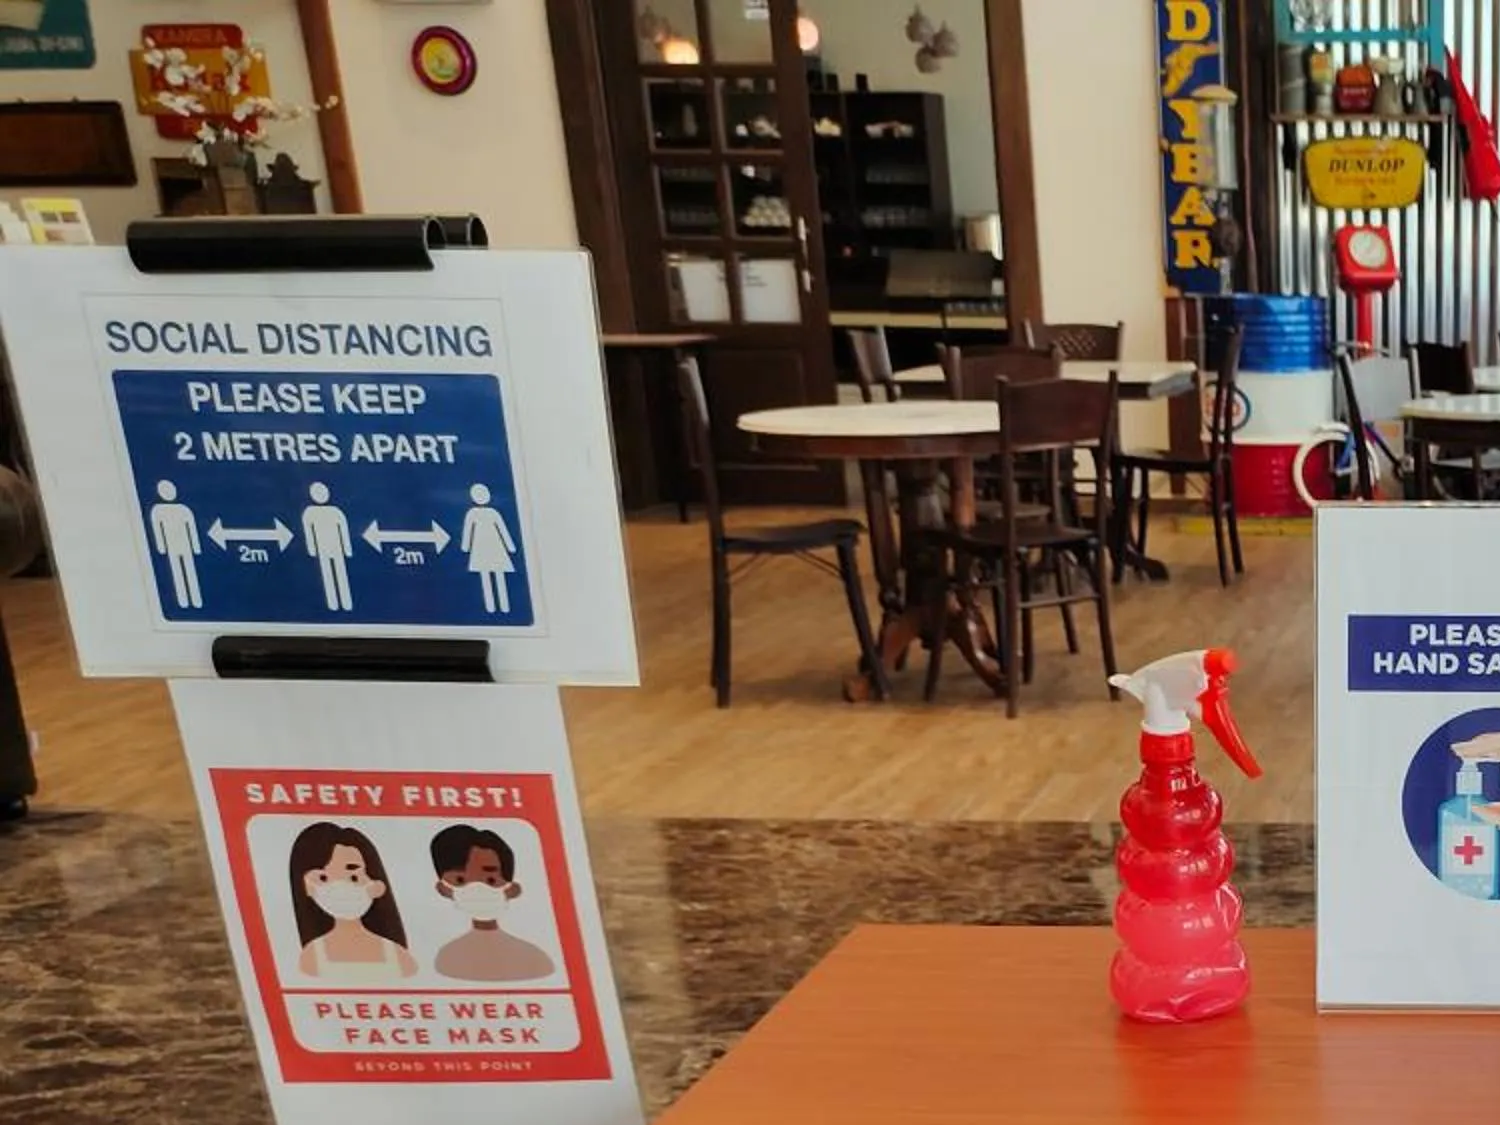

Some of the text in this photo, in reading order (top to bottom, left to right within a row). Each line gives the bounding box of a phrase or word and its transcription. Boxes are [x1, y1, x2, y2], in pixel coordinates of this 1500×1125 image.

[1328, 158, 1405, 174] DUNLOP
[105, 321, 493, 357] SOCIAL DISTANCING
[187, 382, 426, 415] PLEASE KEEP
[174, 432, 458, 464] 2 METRES APART
[239, 545, 269, 563] 2m
[393, 547, 424, 565] 2m
[1373, 652, 1460, 675] HAND
[244, 783, 523, 808] SAFETY FIRST!
[314, 1002, 544, 1020] PLEASE WEAR
[344, 1027, 541, 1045] FACE MASK
[354, 1060, 533, 1073] BEYOND THIS POINT
